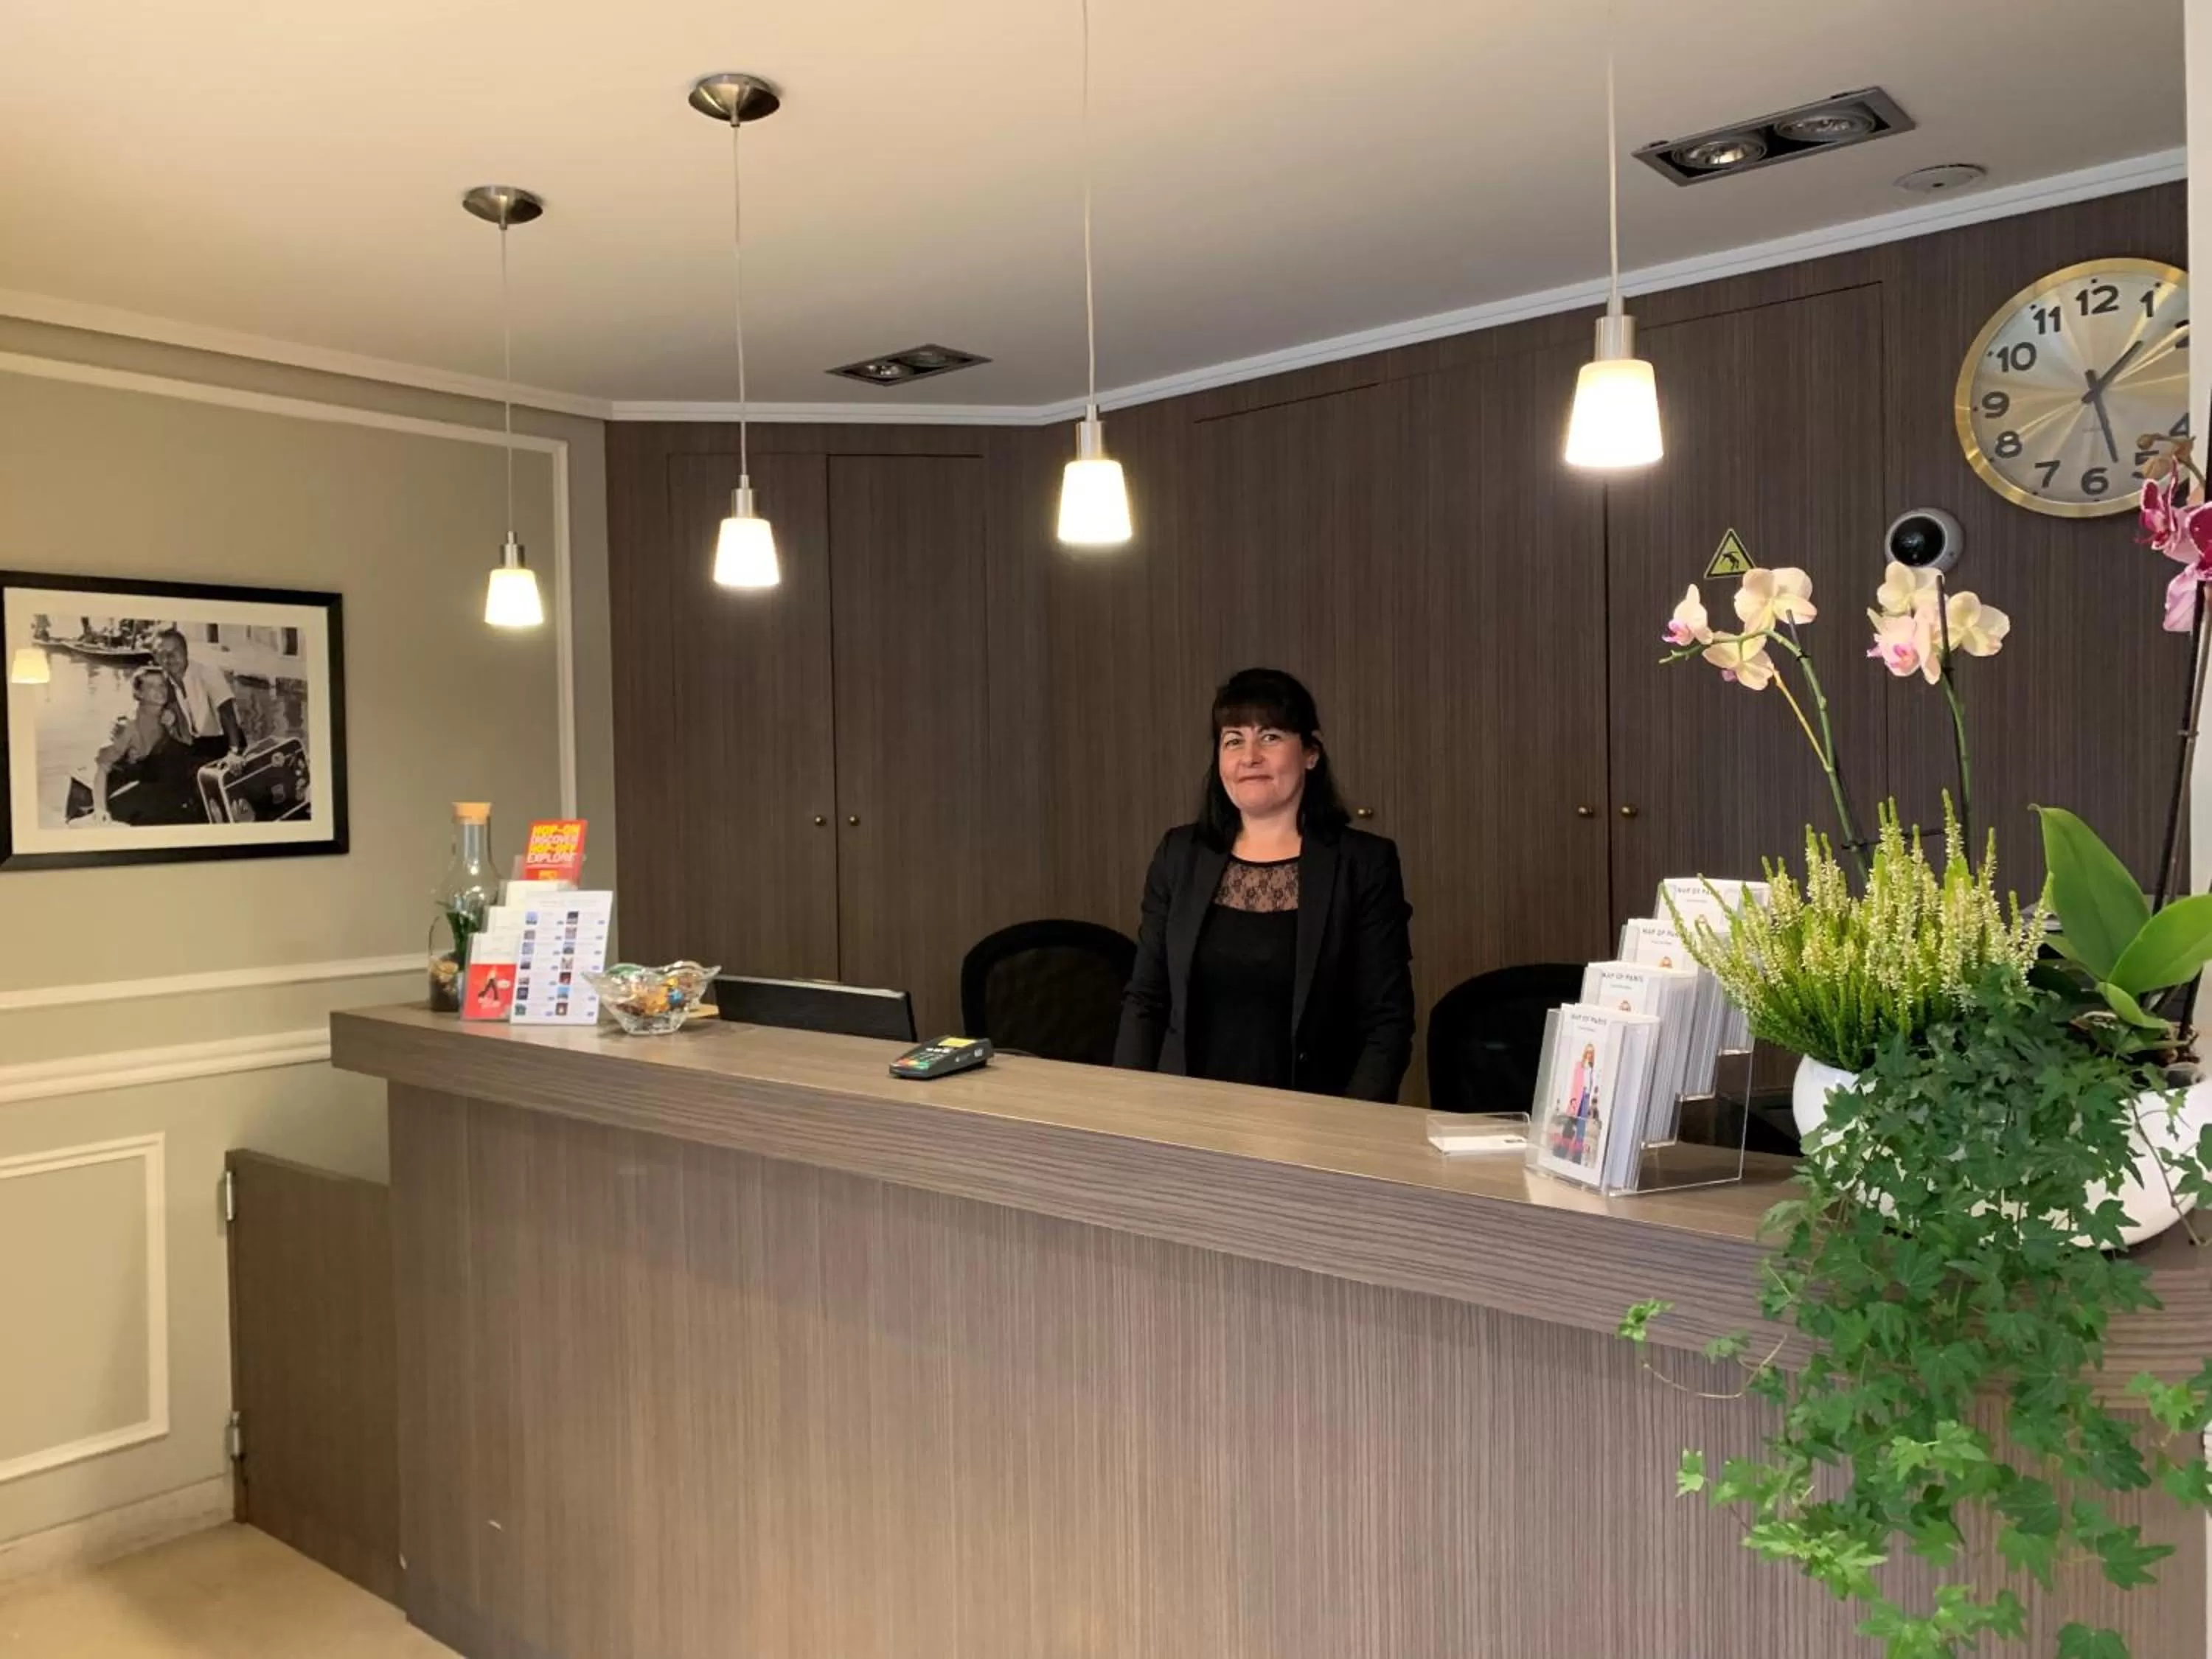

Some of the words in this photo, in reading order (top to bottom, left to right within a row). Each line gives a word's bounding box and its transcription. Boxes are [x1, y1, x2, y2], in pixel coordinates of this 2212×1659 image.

[2076, 285, 2120, 316] 12
[2140, 290, 2154, 318] 1
[2033, 306, 2062, 335] 11
[1996, 341, 2037, 373] 10
[1981, 391, 2010, 419] 9
[1994, 430, 2023, 459] 8
[2034, 459, 2061, 488] 7
[2080, 467, 2110, 496] 6
